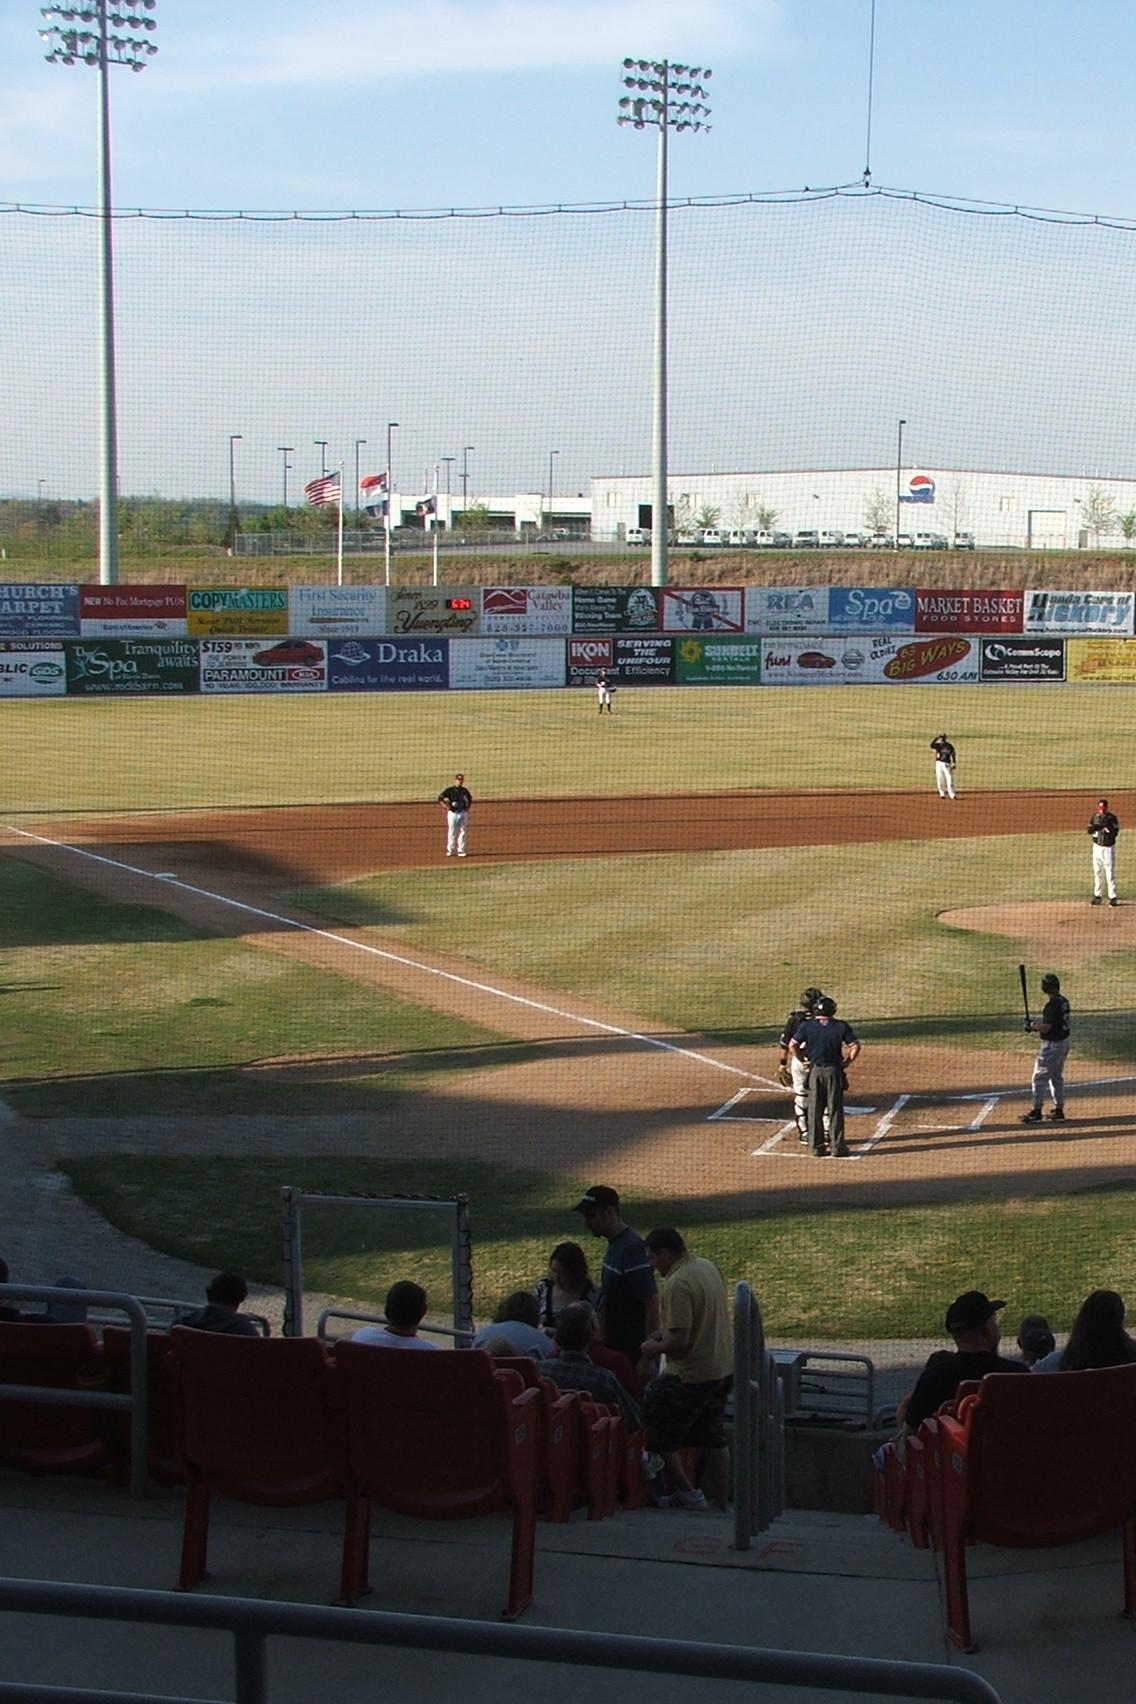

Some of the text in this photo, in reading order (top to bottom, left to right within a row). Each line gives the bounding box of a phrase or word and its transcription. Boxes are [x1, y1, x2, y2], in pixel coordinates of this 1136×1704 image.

[165, 596, 184, 605] PLUS
[191, 592, 285, 609] COPYMASTERS
[300, 588, 377, 604] First Security
[528, 590, 570, 600] Catawba
[1118, 595, 1132, 605] of
[532, 600, 564, 611] Valley
[845, 590, 893, 620] Spa
[917, 597, 1023, 615] MARKET BASKET
[312, 605, 367, 617] Insurance
[394, 610, 478, 634] Yuengling
[11, 642, 64, 650] SOLUTIONS
[616, 640, 672, 648] SERVING
[872, 638, 892, 648] REAL
[120, 640, 200, 658] Tranquility
[377, 643, 443, 663] Draka
[571, 642, 610, 662] IKON
[633, 648, 657, 656] THE
[704, 645, 759, 656] SUNBELT
[1006, 648, 1062, 657] CommScope
[158, 655, 199, 668] awaits
[616, 657, 671, 665] UNIFOUR
[889, 641, 966, 677] BIG WAYS
[88, 652, 138, 681] Spa
[625, 667, 671, 676] Efficiency
[205, 670, 286, 681] PARAMOUNT
[331, 675, 365, 686] Cabling
[380, 674, 395, 683] the
[398, 674, 417, 683] real
[936, 671, 977, 681] 630 AM
[757, 1540, 802, 1560] F
